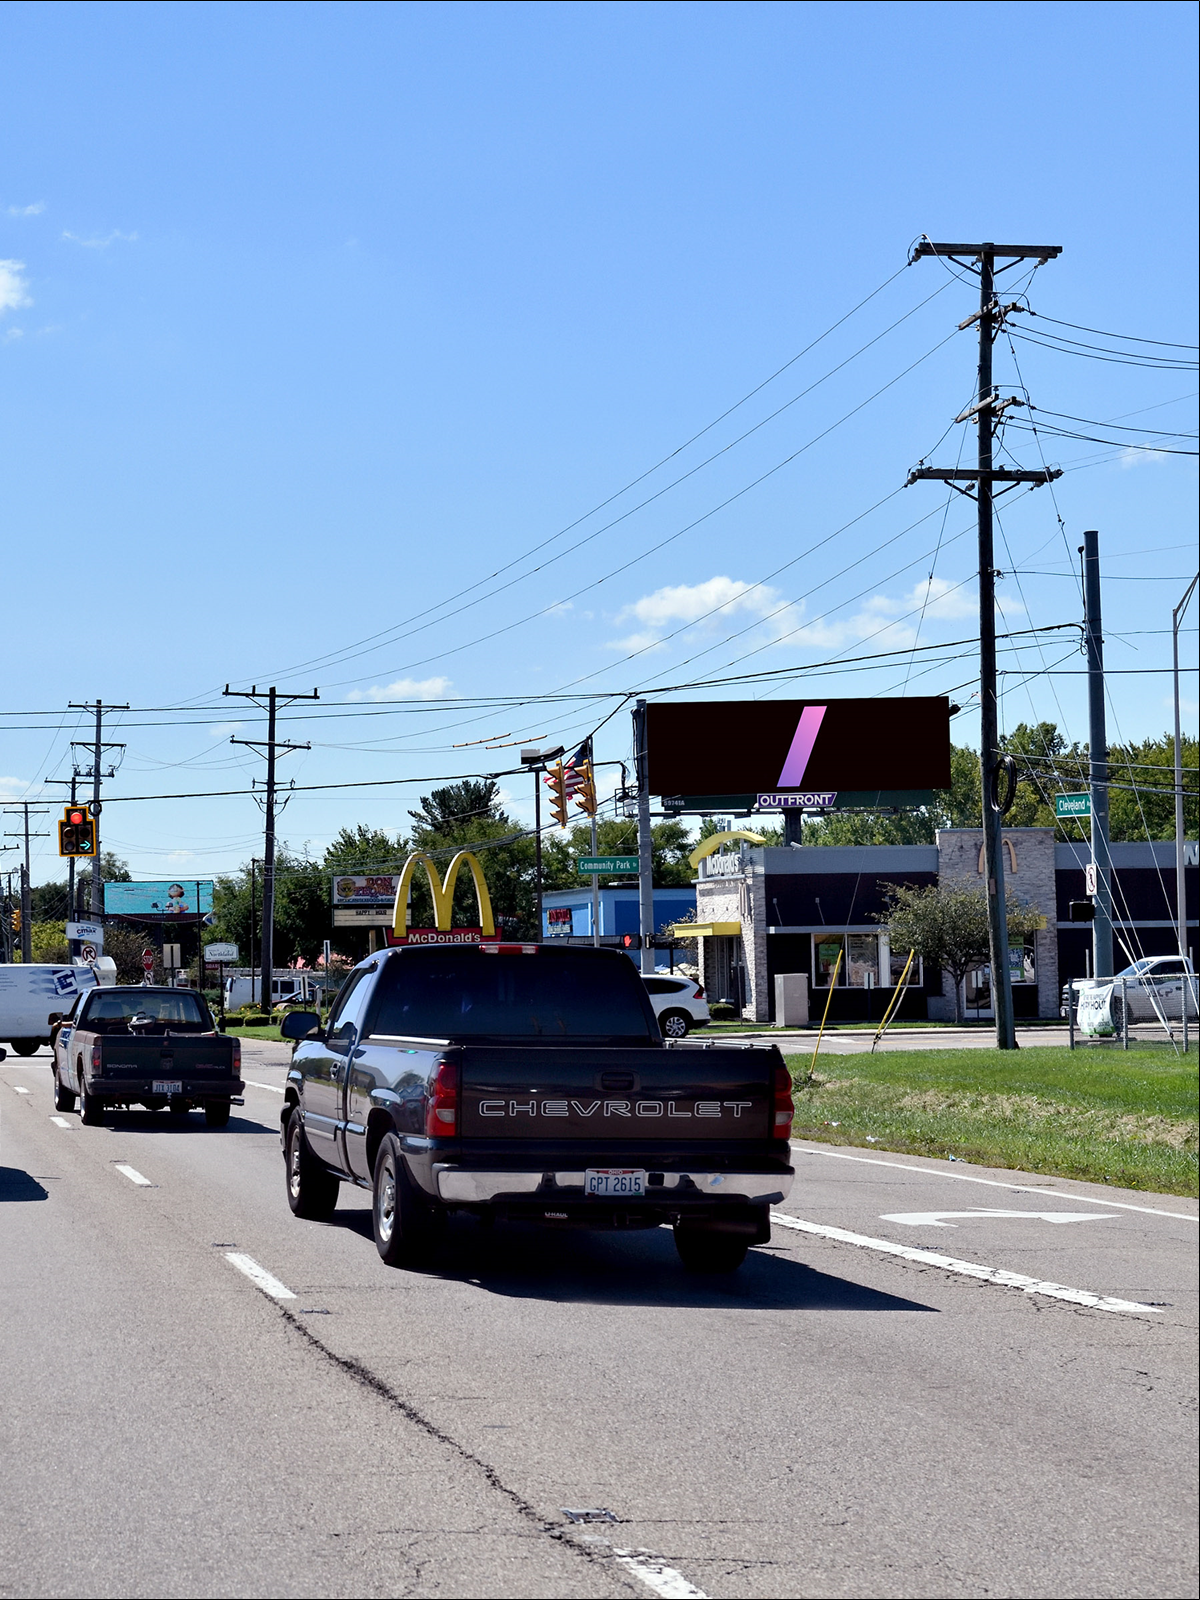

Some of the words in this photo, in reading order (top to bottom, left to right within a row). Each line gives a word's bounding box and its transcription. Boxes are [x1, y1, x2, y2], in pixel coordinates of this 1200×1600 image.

[760, 794, 832, 806] OUTFRONT
[1058, 799, 1086, 811] Cleveland
[580, 860, 614, 871] Community
[616, 860, 630, 869] Park
[365, 877, 394, 886] DON
[354, 886, 397, 898] TEQUIL
[408, 933, 481, 943] McDonald's
[143, 956, 152, 964] STOP
[479, 1100, 752, 1118] CHEVROLET
[590, 1177, 610, 1192] GPT
[614, 1177, 641, 1192] 2615
